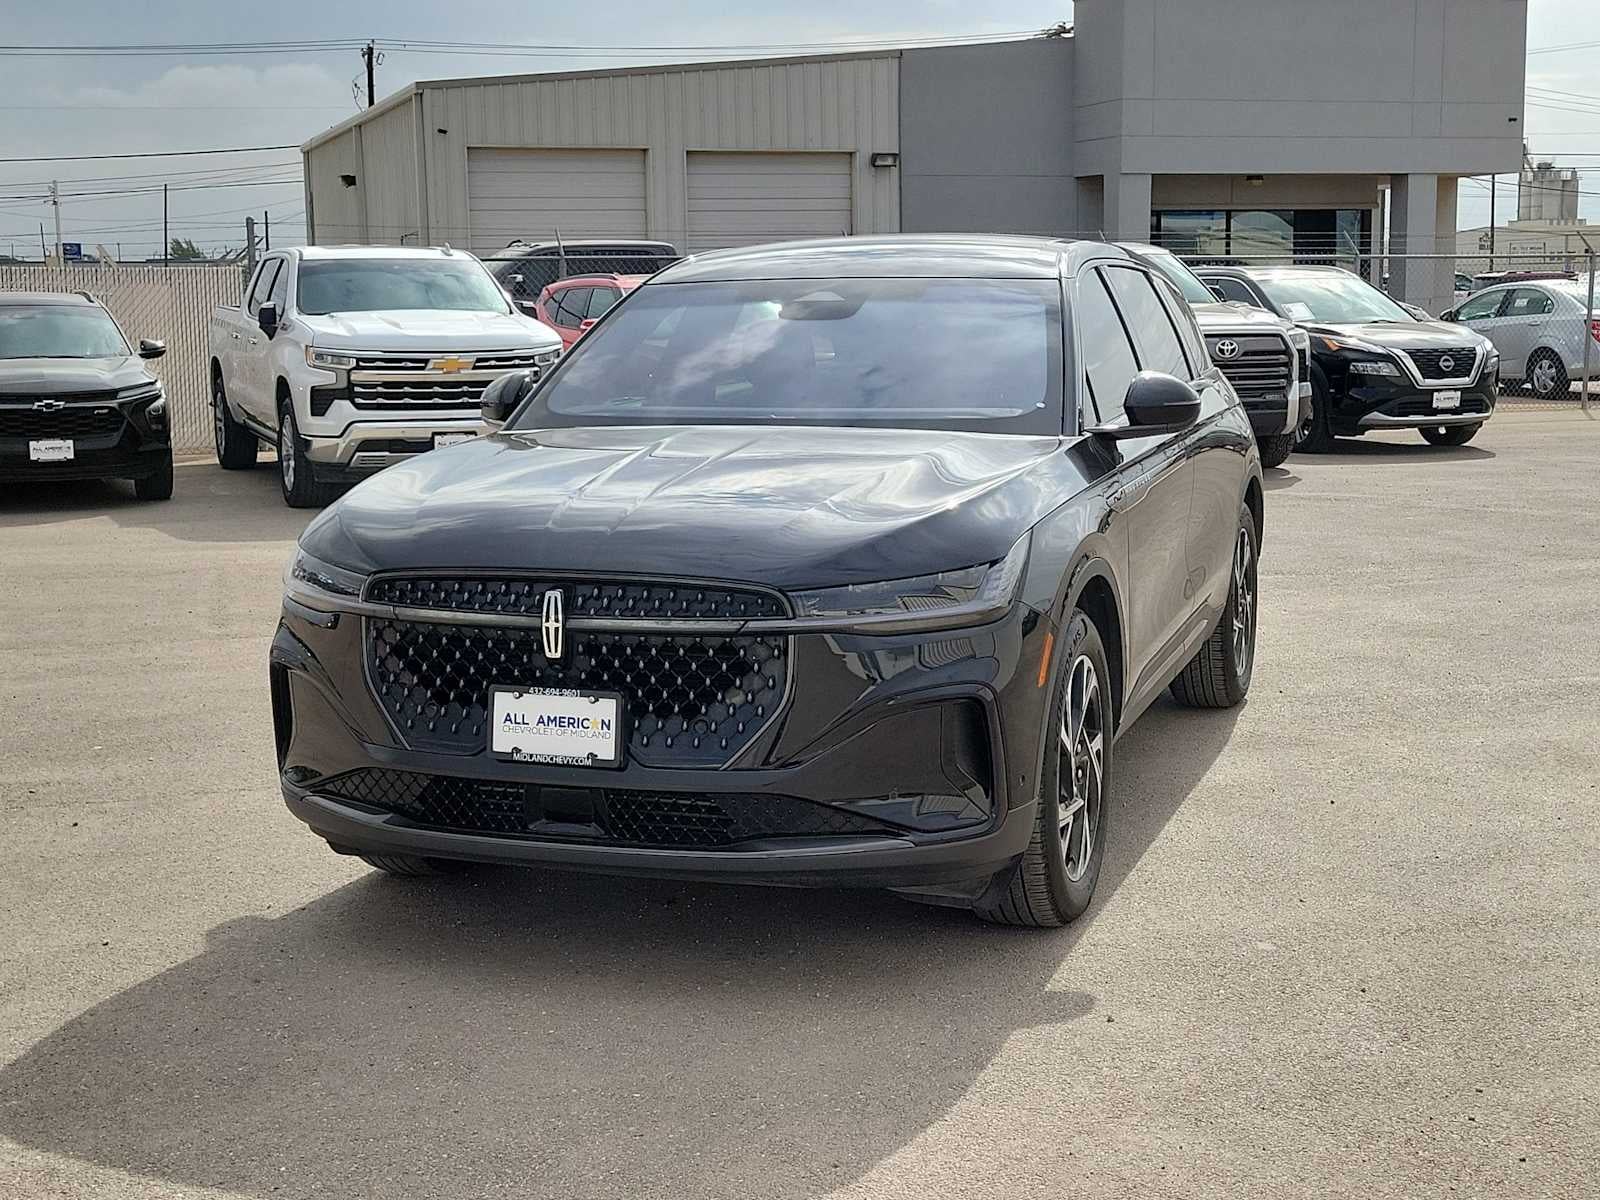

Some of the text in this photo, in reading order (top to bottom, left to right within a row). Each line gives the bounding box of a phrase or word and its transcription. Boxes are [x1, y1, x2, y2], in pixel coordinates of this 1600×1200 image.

[529, 687, 580, 698] 432-694-9601
[503, 713, 529, 725] ALL
[502, 725, 611, 740] CHEVROLET OF MIDLAND
[513, 753, 592, 766] MIDLANDCHEVY.COM
